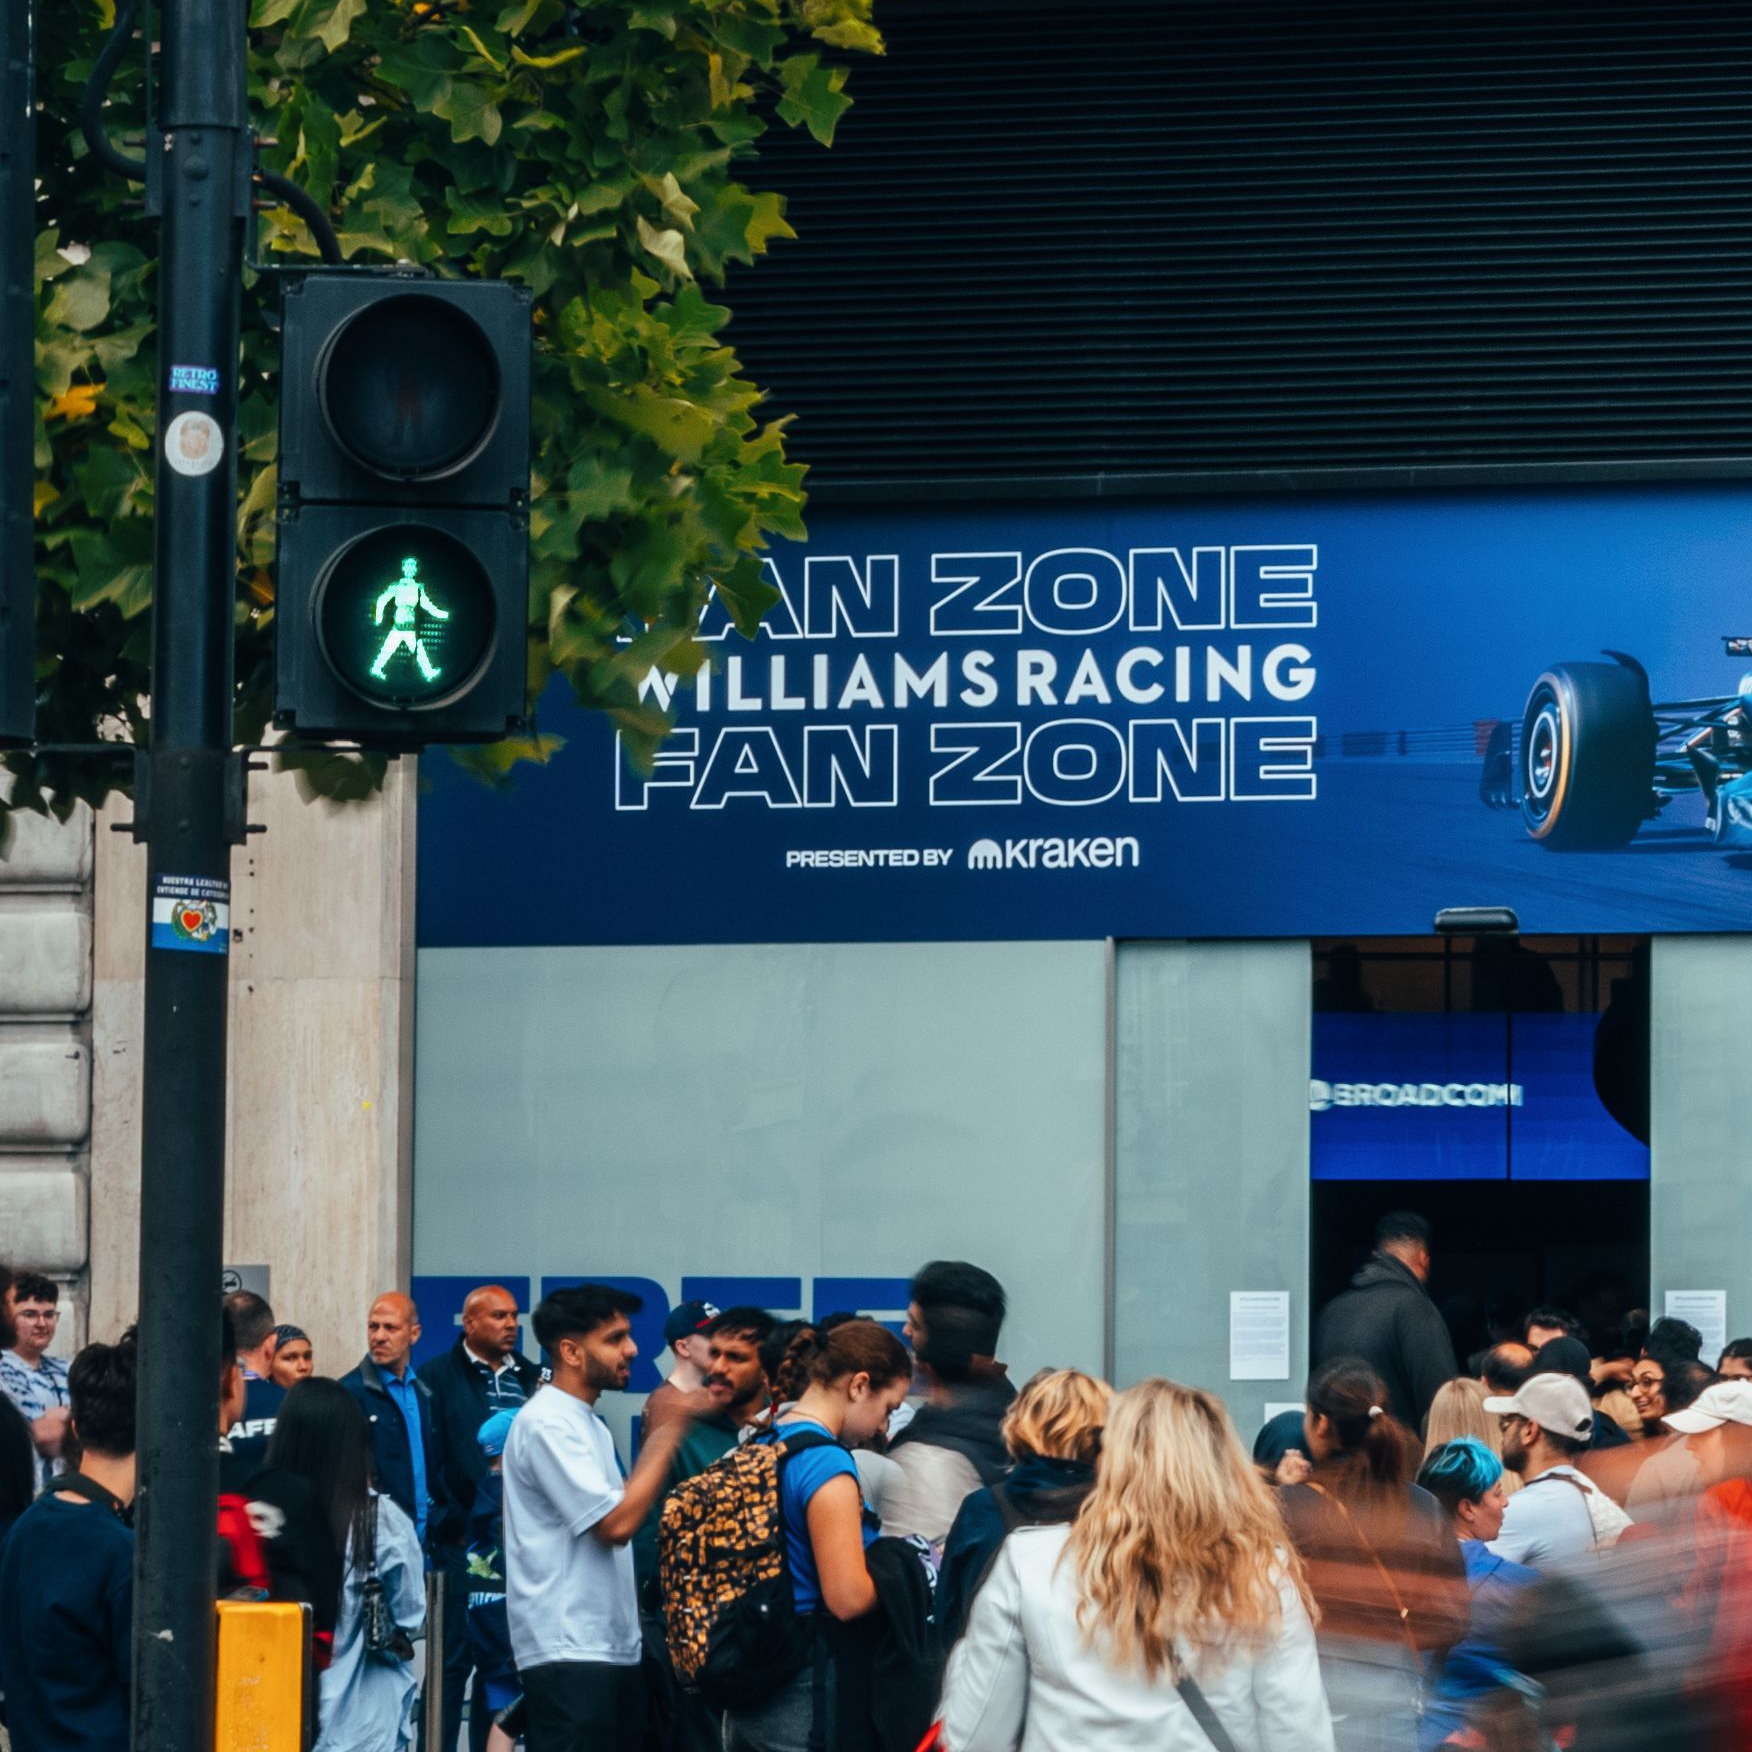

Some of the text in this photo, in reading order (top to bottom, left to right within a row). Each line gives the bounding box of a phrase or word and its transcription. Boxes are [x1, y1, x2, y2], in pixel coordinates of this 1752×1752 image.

[929, 544, 1318, 637] ZONE
[615, 716, 1318, 811] FAN ZONE
[786, 849, 919, 868] PRESENTED
[923, 848, 953, 866] BY
